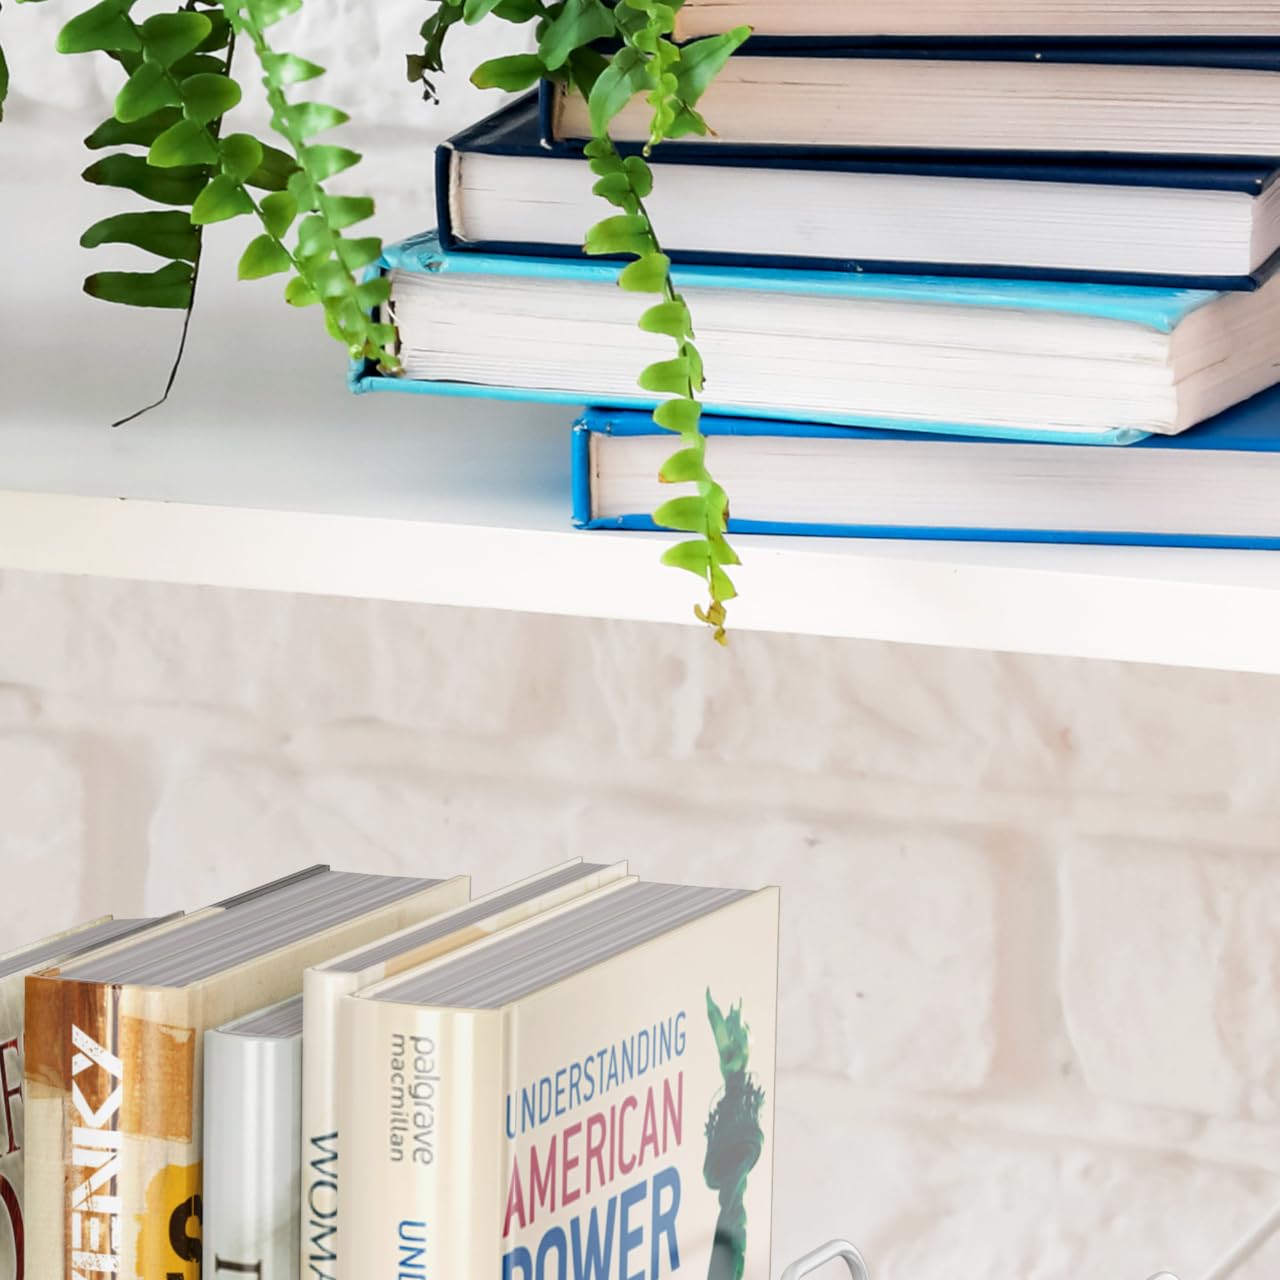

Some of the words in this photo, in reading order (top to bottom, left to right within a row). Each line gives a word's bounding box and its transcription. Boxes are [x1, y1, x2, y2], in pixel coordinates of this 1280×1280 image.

[389, 1032, 406, 1163] macmillan
[410, 1036, 440, 1165] palgrave
[506, 1010, 687, 1140] UNDERSTANDING
[502, 1071, 684, 1239] AMERICAN
